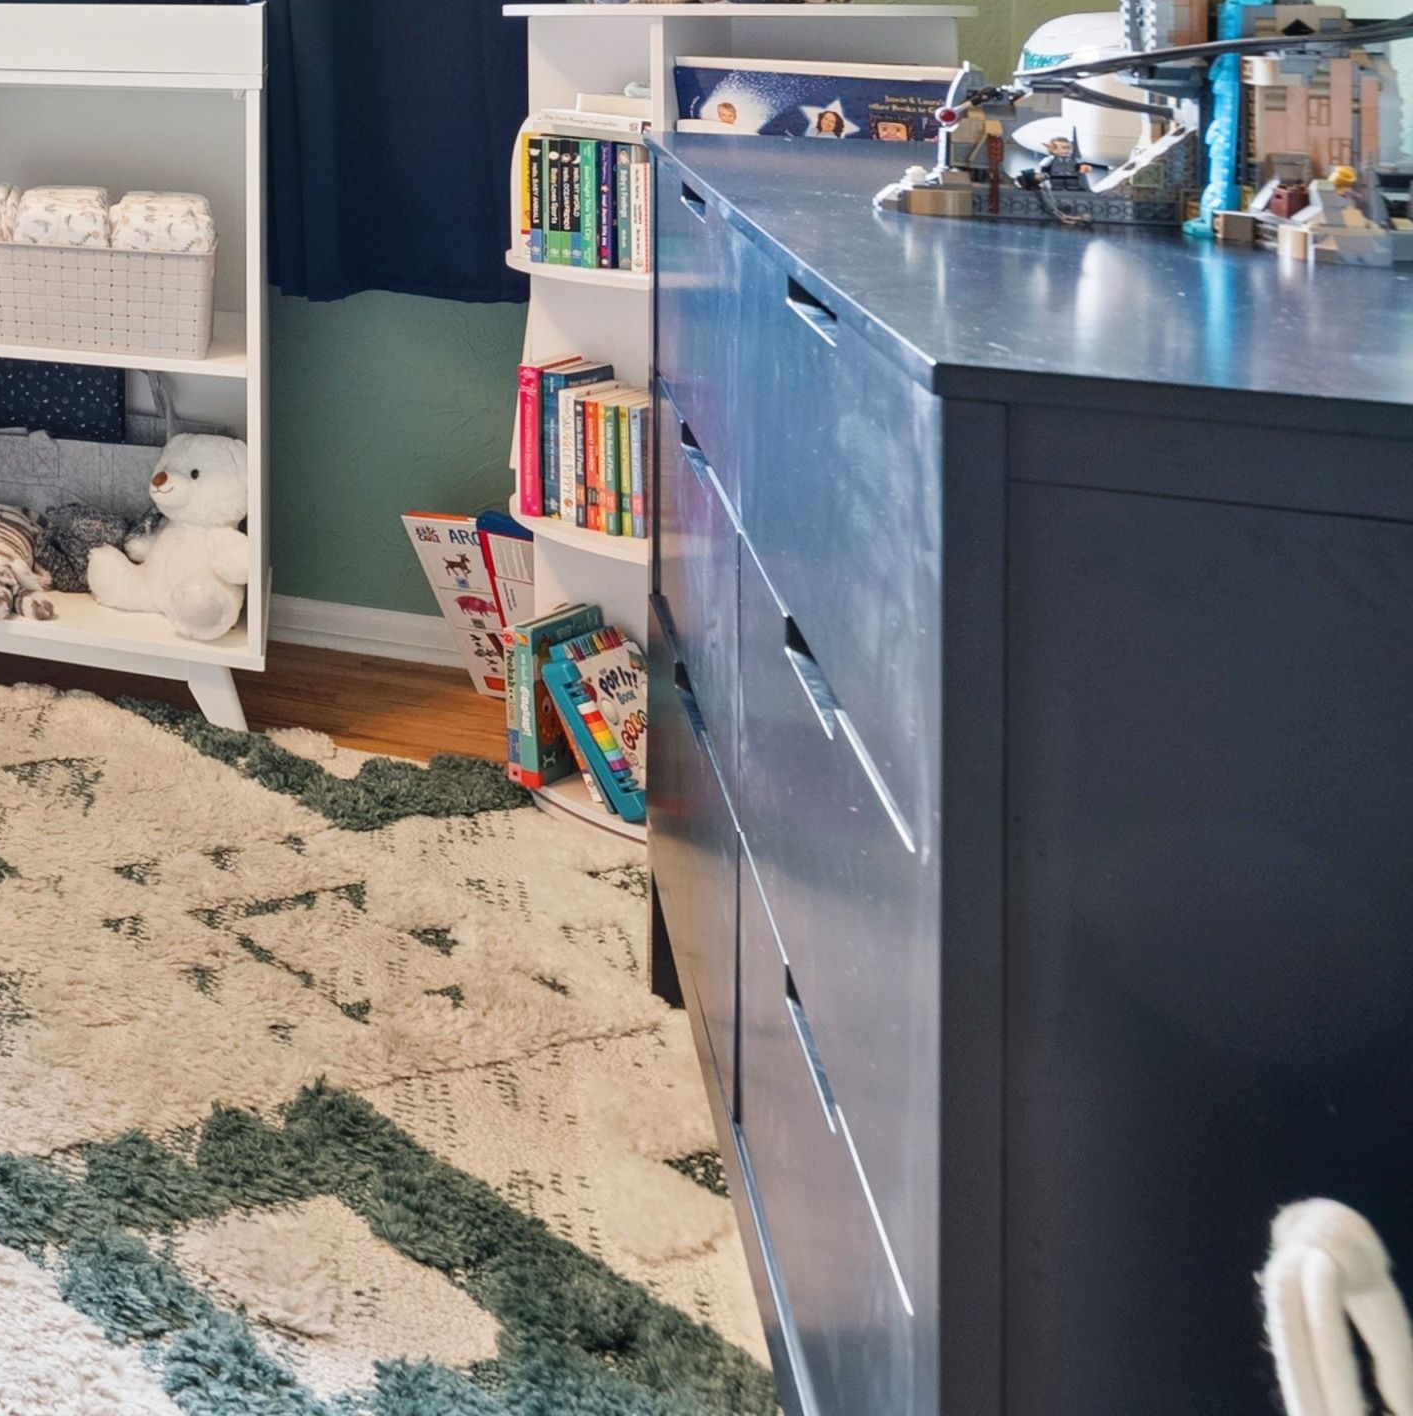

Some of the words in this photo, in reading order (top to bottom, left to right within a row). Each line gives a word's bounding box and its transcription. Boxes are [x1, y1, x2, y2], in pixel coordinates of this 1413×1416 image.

[549, 202, 558, 224] Sports
[584, 214, 593, 228] York
[584, 228, 592, 241] City
[449, 529, 481, 547] ARO
[598, 669, 620, 699] POP
[617, 665, 638, 690] IT!
[622, 709, 648, 750] COLO
